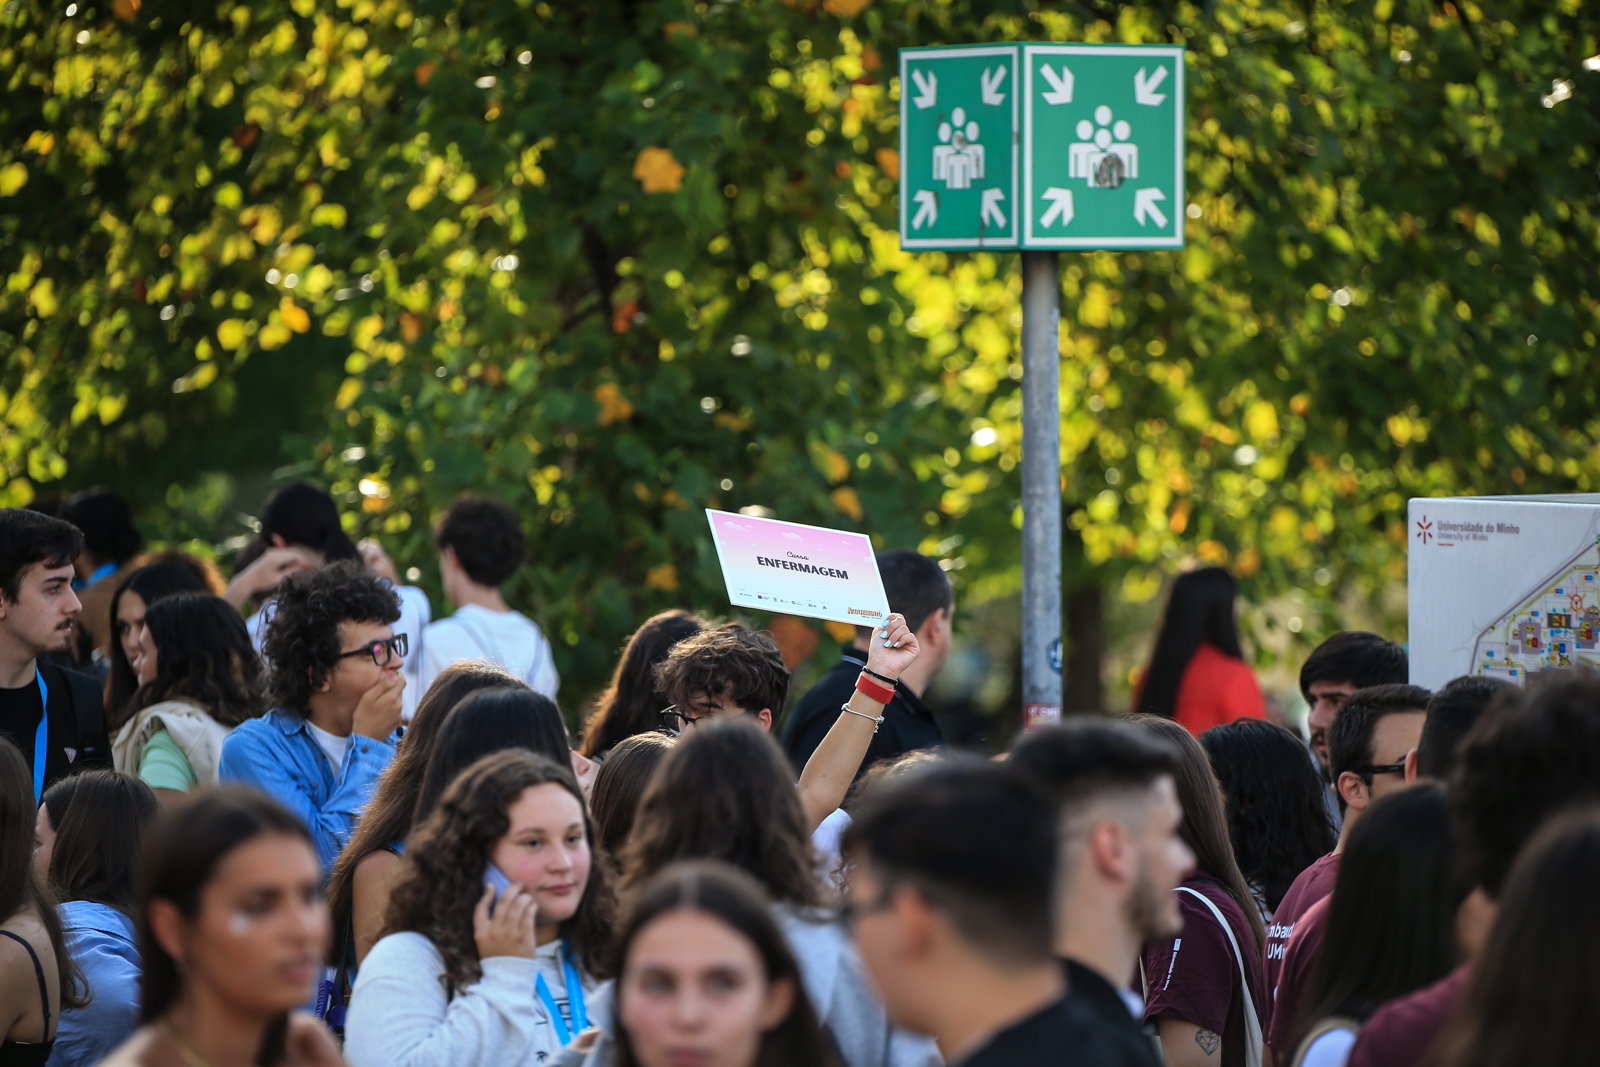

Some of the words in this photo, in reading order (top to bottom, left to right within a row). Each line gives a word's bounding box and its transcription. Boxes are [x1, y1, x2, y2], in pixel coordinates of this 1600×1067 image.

[1437, 520, 1483, 533] Universidade
[1486, 523, 1495, 533] do
[1496, 523, 1520, 534] Minho
[1437, 532, 1464, 542] University
[1465, 533, 1471, 541] of
[1471, 533, 1489, 542] Minho
[786, 550, 810, 561] Curso
[756, 556, 849, 580] ENFERMAGEM
